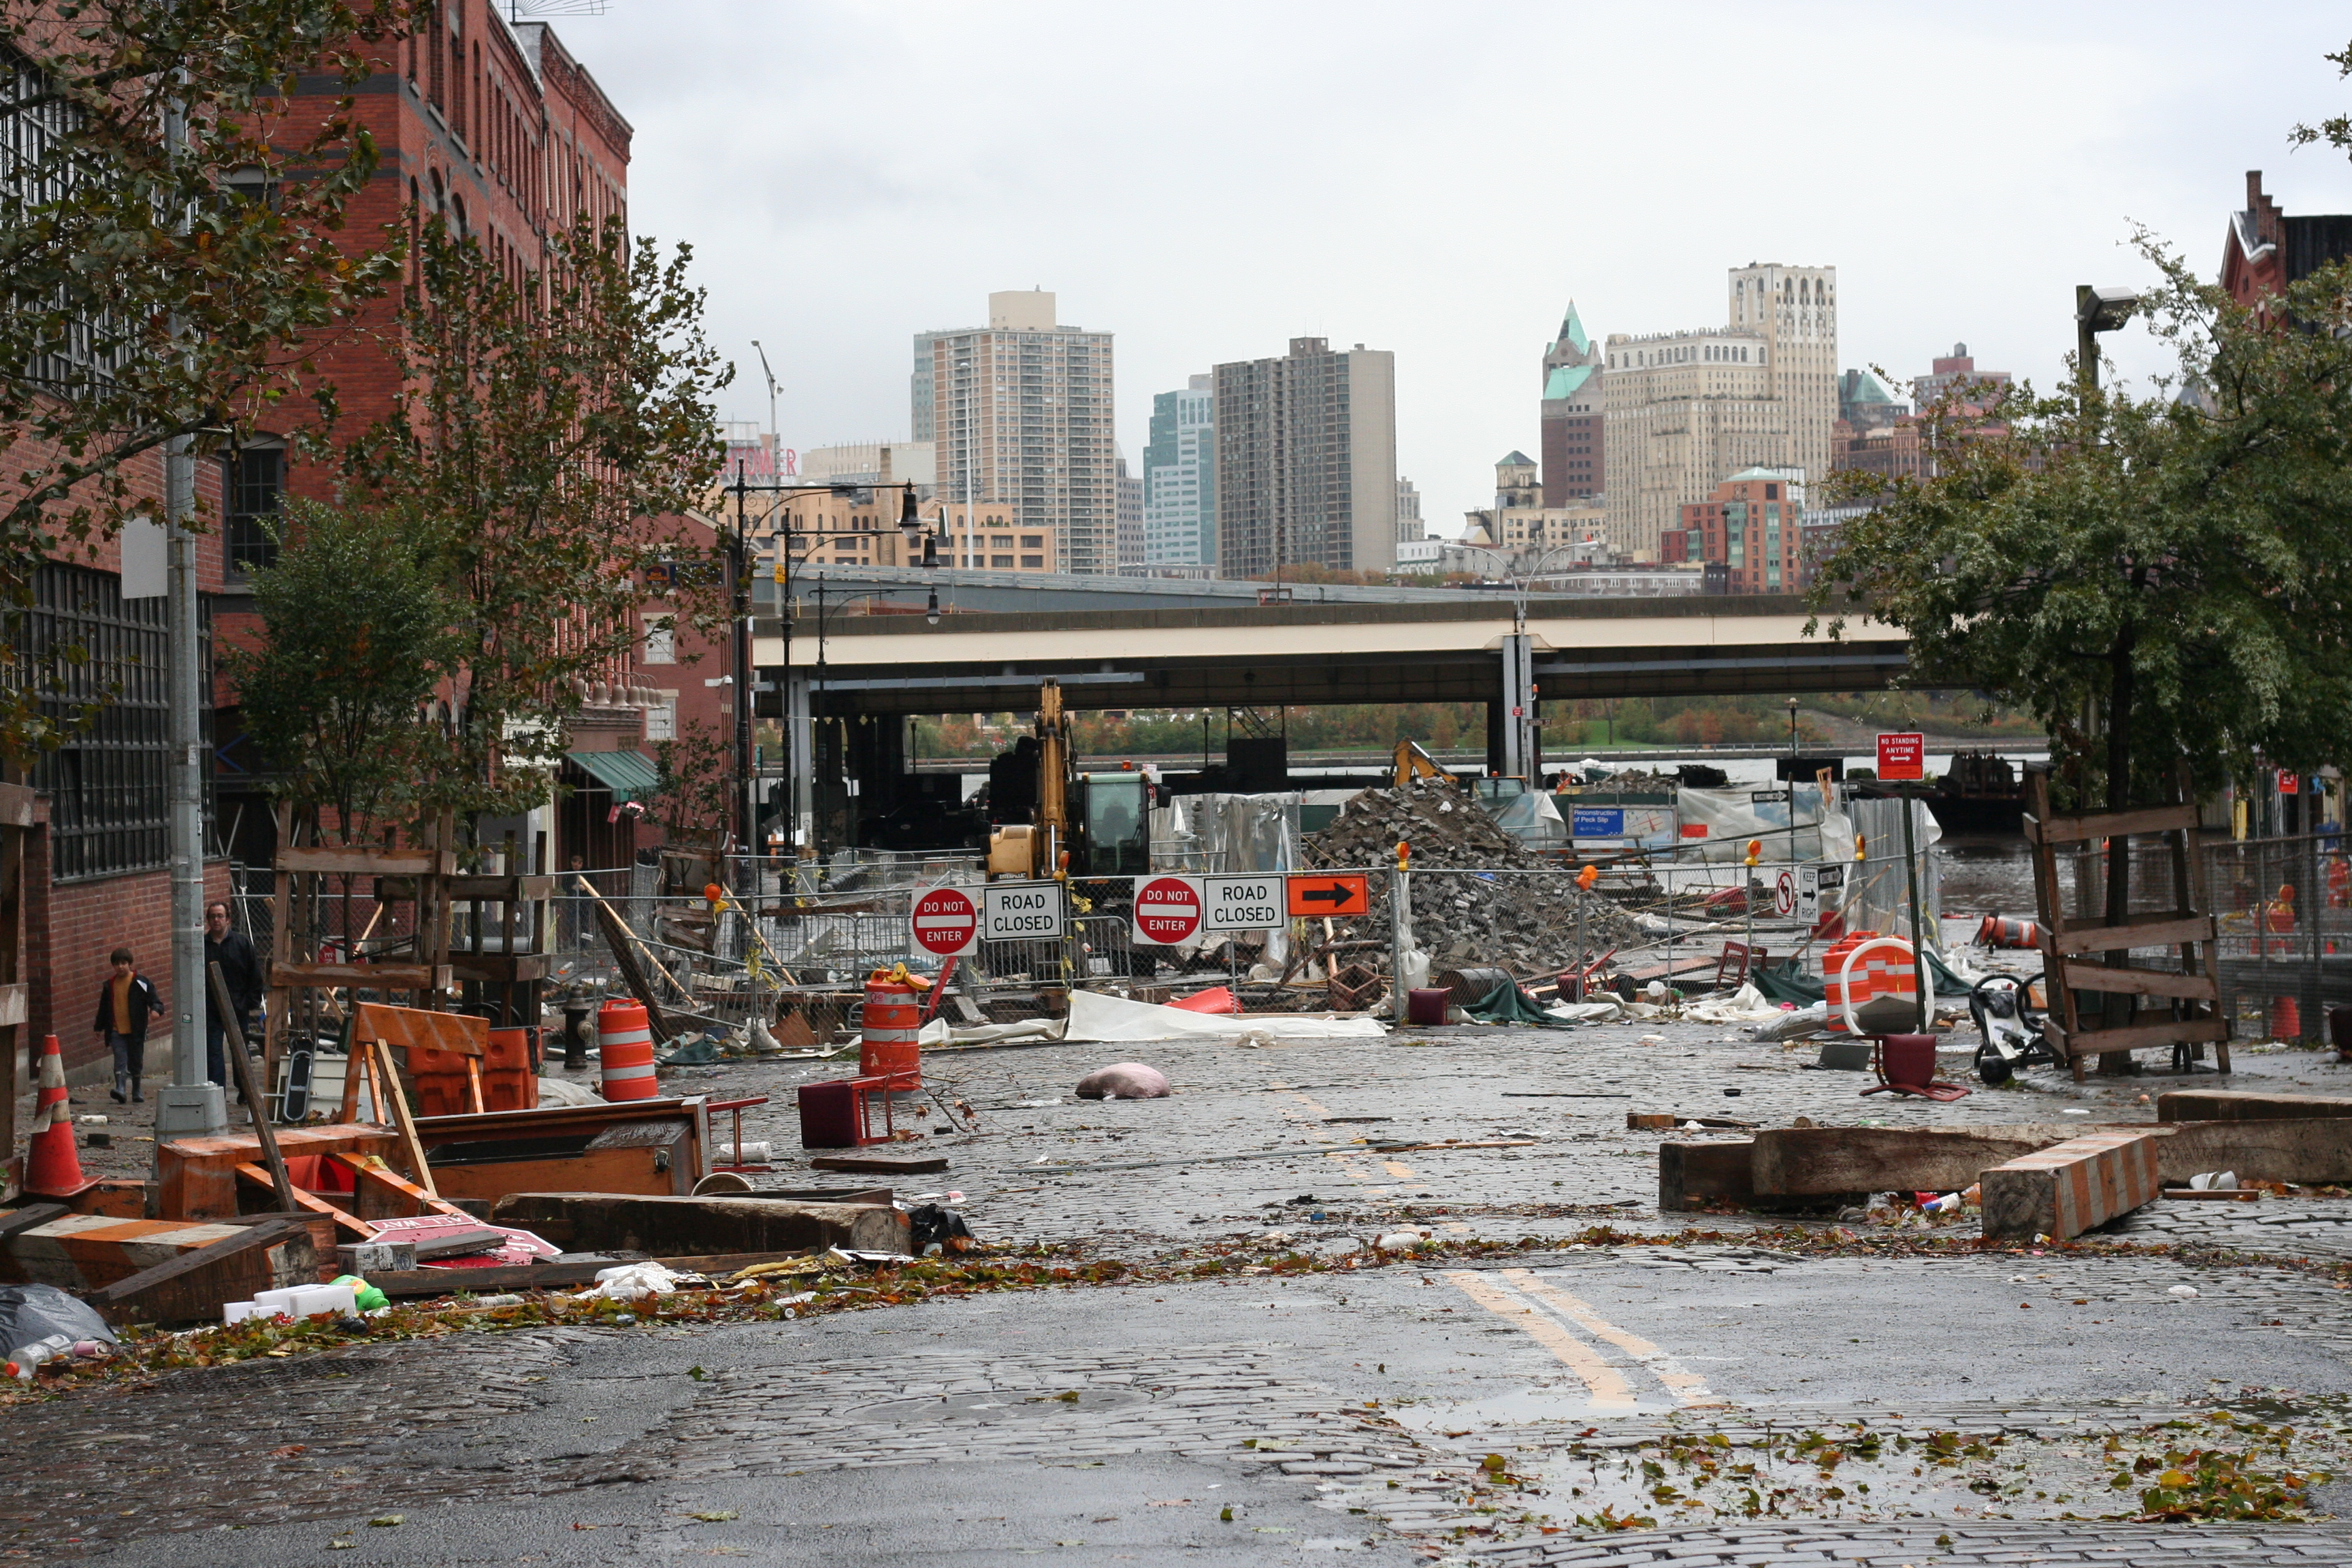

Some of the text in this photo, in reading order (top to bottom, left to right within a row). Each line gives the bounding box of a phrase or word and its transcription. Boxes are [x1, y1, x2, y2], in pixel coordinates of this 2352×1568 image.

[1803, 872, 1816, 882] KEEP
[1147, 890, 1189, 902] DO NOT
[1223, 885, 1267, 901] ROAD
[924, 901, 964, 913] DO NOT
[1001, 894, 1045, 911] ROAD
[1215, 907, 1275, 923] CLOSED
[1801, 907, 1816, 919] RIGHT
[994, 915, 1054, 932] CLOSED
[1149, 920, 1186, 931] ENTER
[926, 931, 962, 942] ENTER
[382, 1215, 462, 1229] ALL WAY
